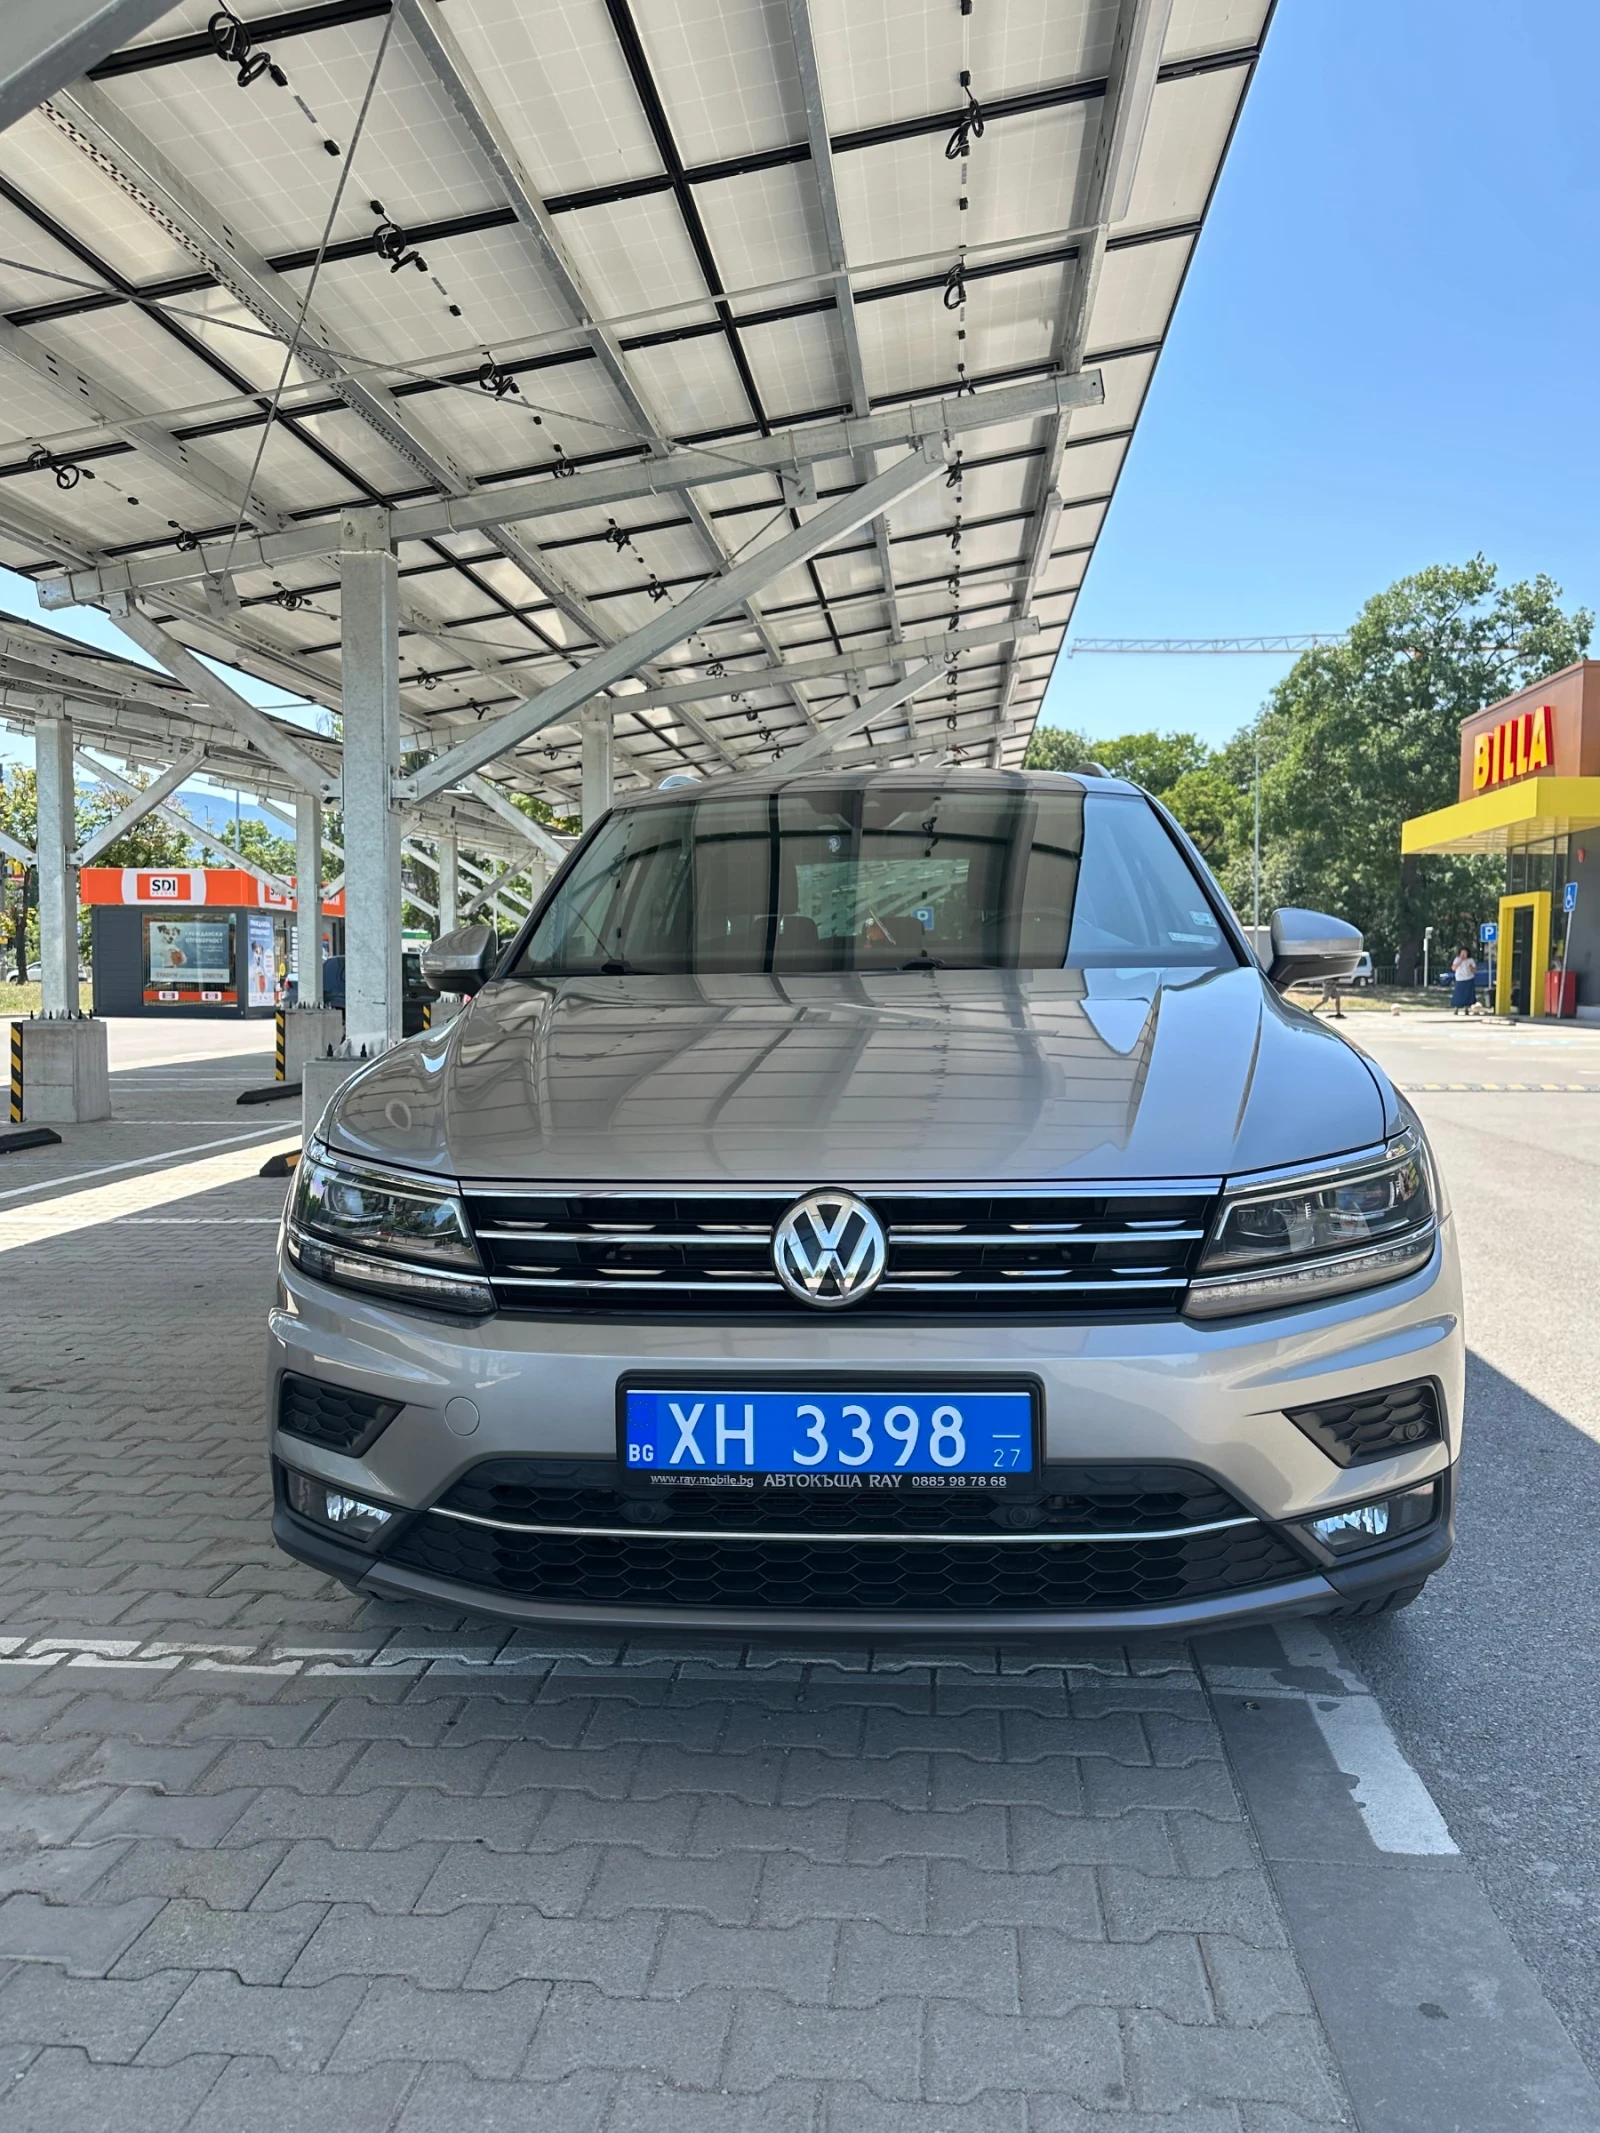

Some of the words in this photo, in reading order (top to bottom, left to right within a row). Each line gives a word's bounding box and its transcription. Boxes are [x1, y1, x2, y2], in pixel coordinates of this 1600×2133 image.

[1473, 706, 1554, 791] BILLA
[152, 879, 176, 892] SDI
[1485, 927, 1494, 939] P
[793, 1405, 966, 1468] 3398
[628, 1444, 654, 1462] BG
[993, 1449, 1021, 1468] 27
[650, 1474, 754, 1488] www.ray.mobile.bg
[763, 1474, 863, 1489] АВТОКЪЩА
[869, 1475, 903, 1489] RAY
[912, 1476, 945, 1487] 0885
[949, 1476, 965, 1487] 98
[970, 1476, 986, 1487] 78
[990, 1476, 1007, 1487] 68
